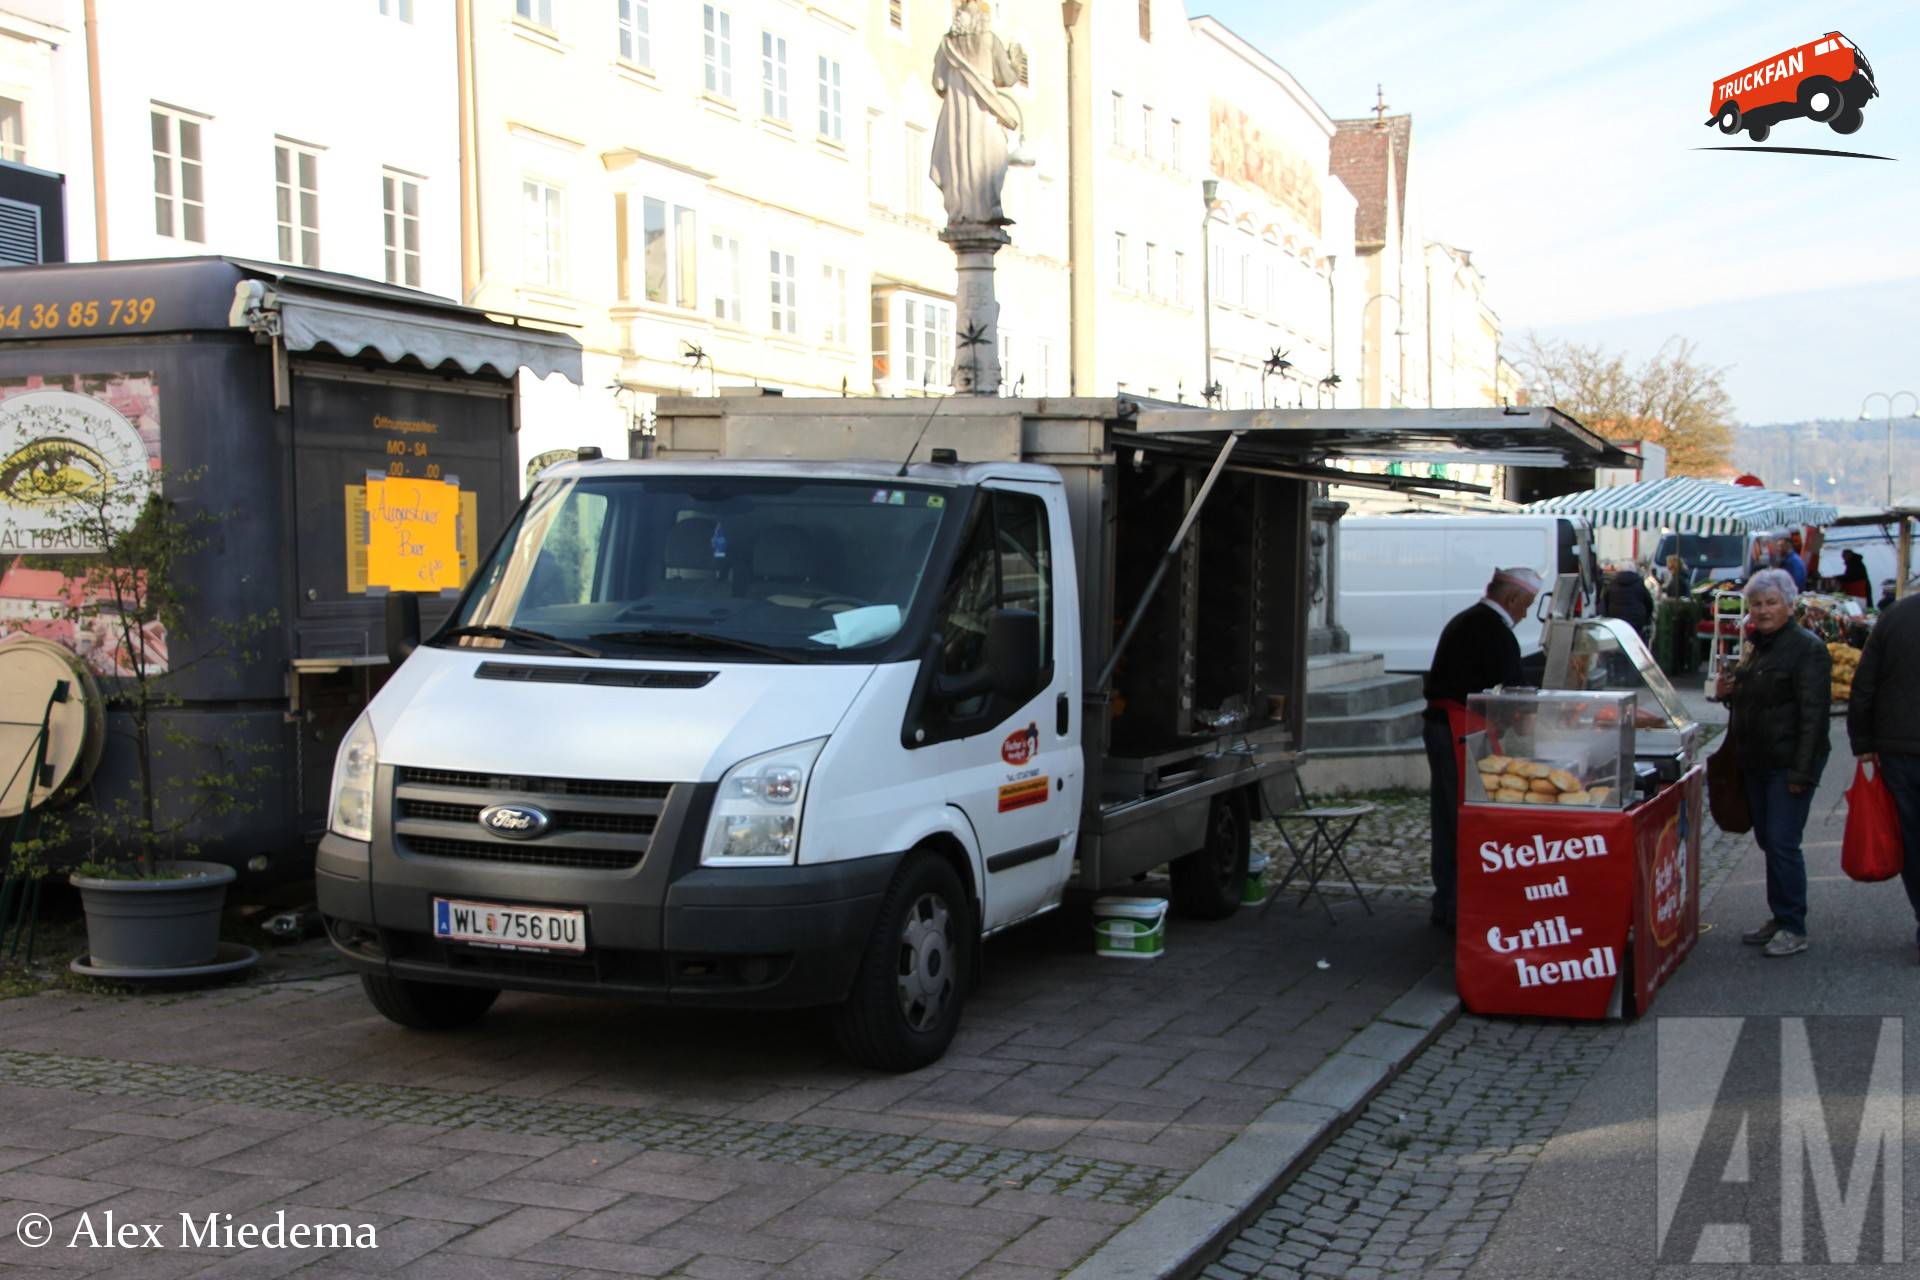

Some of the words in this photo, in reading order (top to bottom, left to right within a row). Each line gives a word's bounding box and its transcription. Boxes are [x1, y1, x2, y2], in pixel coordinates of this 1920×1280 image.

[29, 303, 60, 330] 36
[67, 301, 98, 328] 85
[108, 297, 157, 326] 739
[387, 439, 406, 456] MO
[415, 441, 428, 457] SA
[493, 809, 531, 830] Ford
[1479, 833, 1608, 873] Stelzen
[1524, 876, 1569, 901] und
[454, 908, 483, 934] WL
[1487, 916, 1583, 953] Grill-
[1514, 946, 1617, 988] hendl
